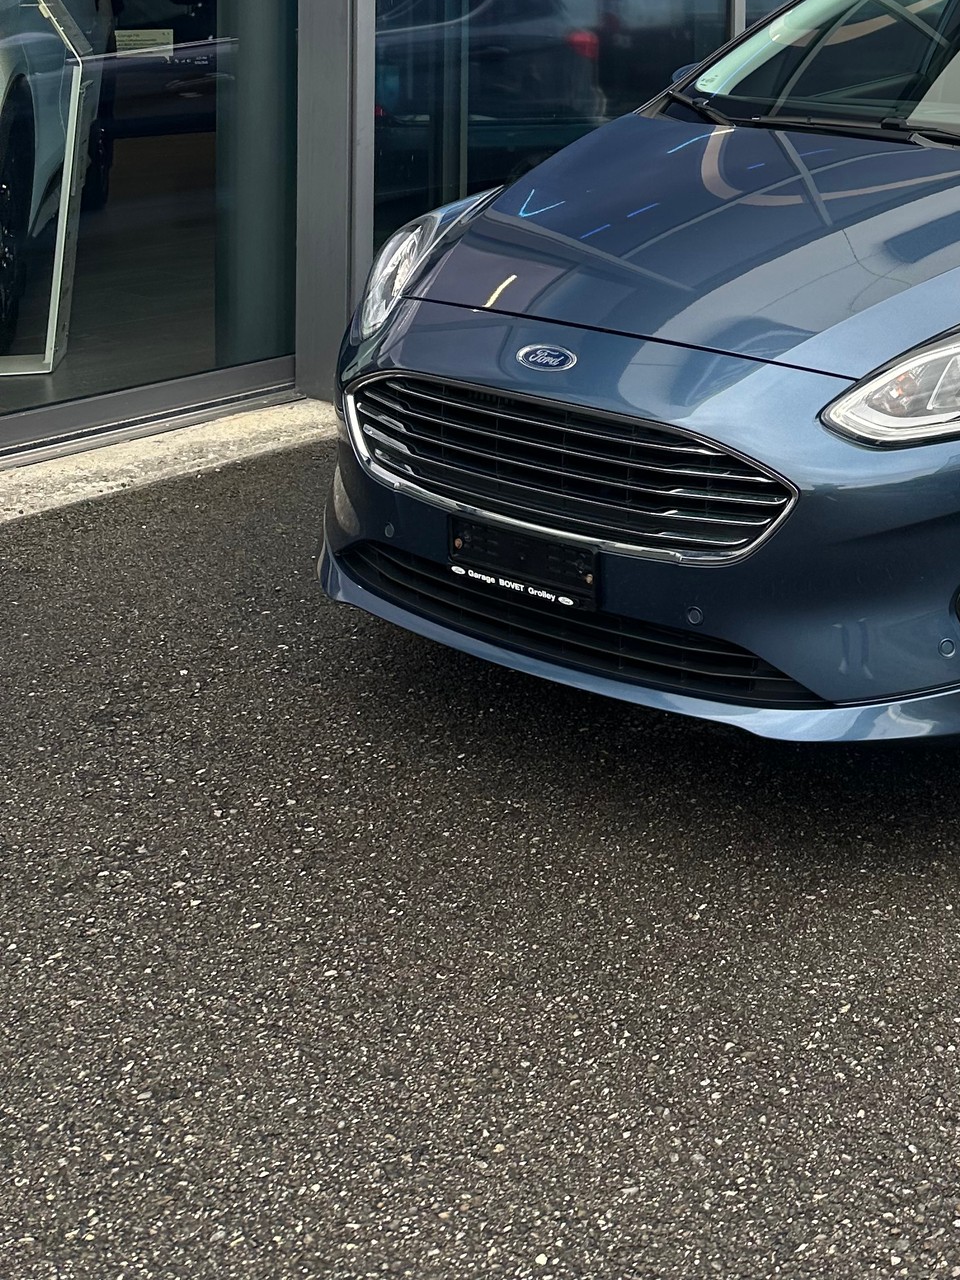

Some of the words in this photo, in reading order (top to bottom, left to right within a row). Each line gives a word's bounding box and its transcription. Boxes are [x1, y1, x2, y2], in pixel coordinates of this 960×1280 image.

[528, 348, 565, 367] Ford
[467, 569, 496, 584] Garage
[498, 578, 525, 592] BOVET
[527, 587, 556, 602] Grolley
